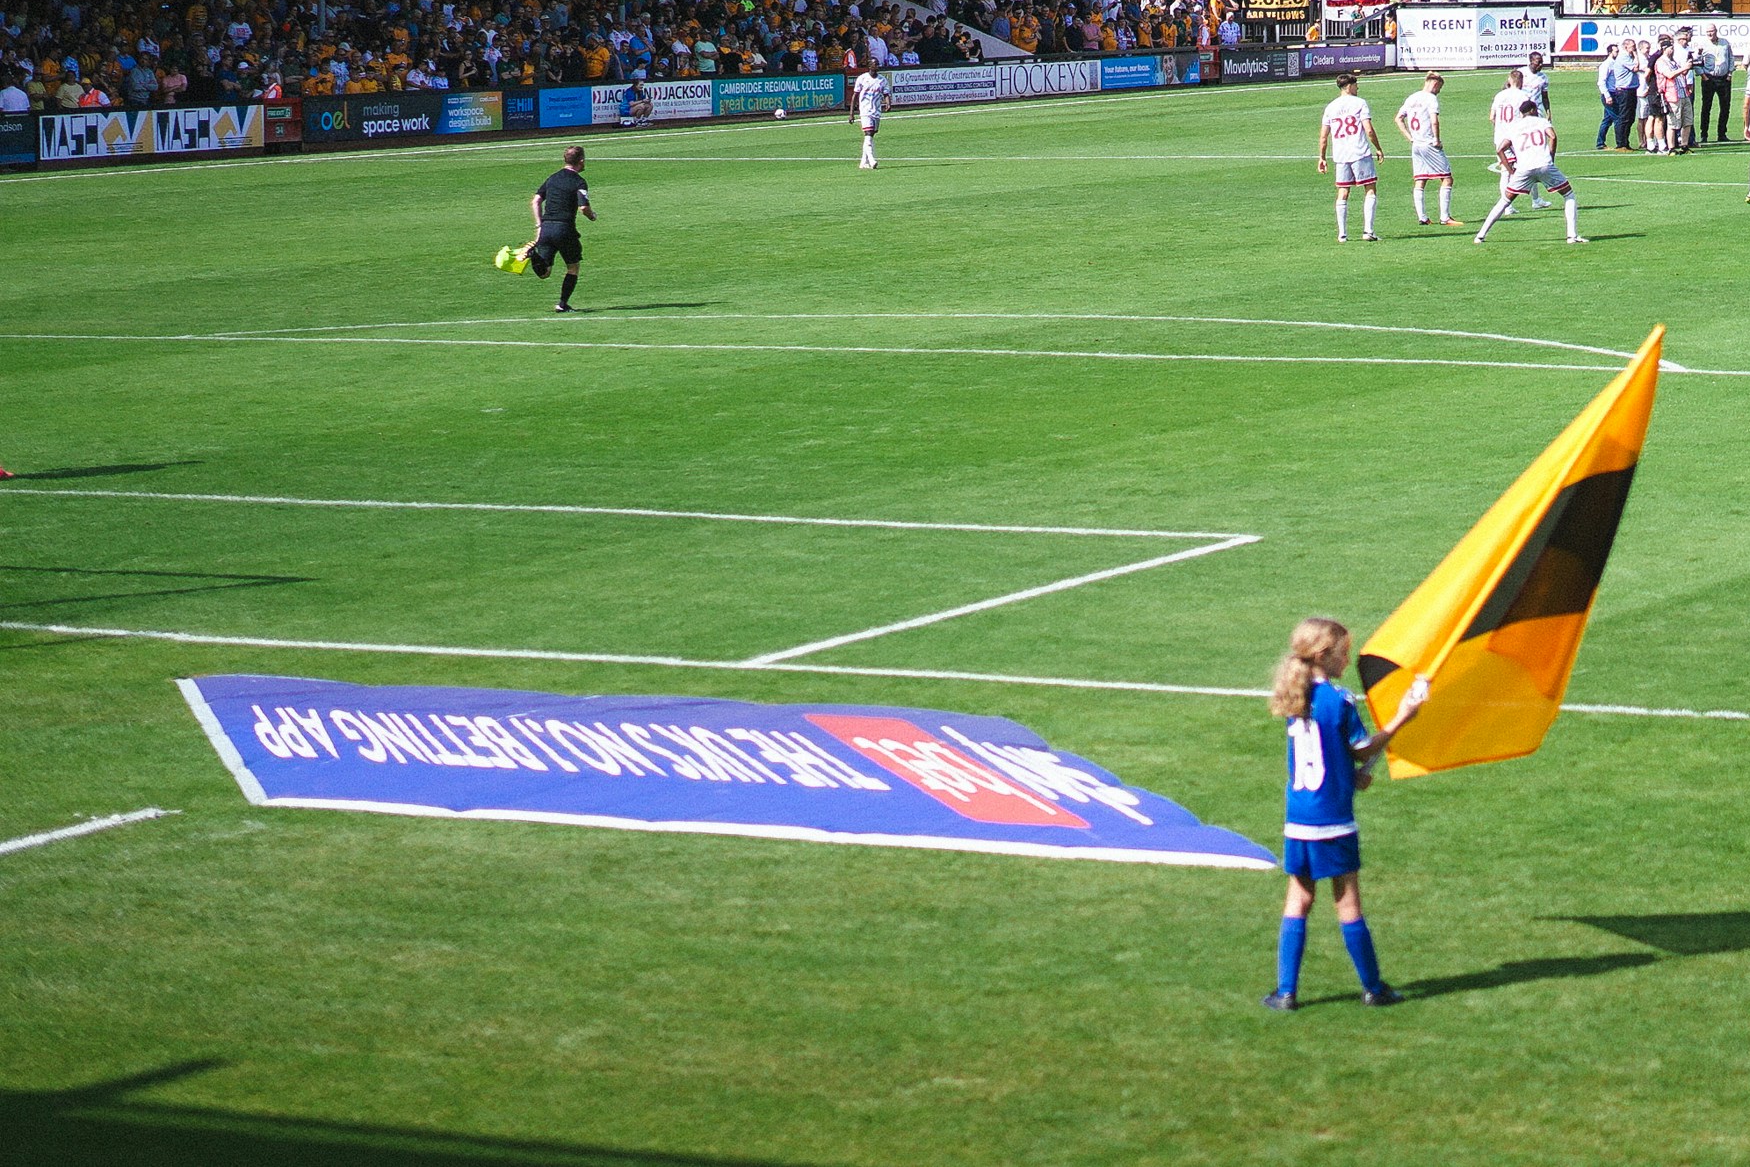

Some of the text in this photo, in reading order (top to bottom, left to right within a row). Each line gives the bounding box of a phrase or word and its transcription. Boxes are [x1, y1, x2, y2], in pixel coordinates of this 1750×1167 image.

[1337, 9, 1344, 18] F
[1422, 19, 1473, 30] REGENT
[1603, 24, 1642, 36] ALAN
[1416, 46, 1473, 54] 01223 711853
[1495, 43, 1517, 51] 01223
[1224, 57, 1268, 77] Movolytics
[1313, 53, 1335, 66] Cledara
[905, 69, 940, 85] Groundworks
[949, 69, 981, 82] Construction
[1000, 62, 1088, 96] HOCKEYS
[662, 84, 711, 101] JACKSON
[719, 81, 763, 95] CAMBRIDGE
[764, 80, 800, 93] REGIONAL
[802, 78, 834, 92] COLLEGE
[362, 101, 400, 118] making
[516, 97, 534, 112] Hill
[719, 95, 745, 115] great
[747, 96, 783, 110] careers
[786, 93, 810, 108] start
[812, 91, 834, 106] here
[448, 106, 484, 118] workspace
[1498, 104, 1514, 123] 10
[362, 114, 430, 137] space work
[448, 117, 470, 130] design
[475, 115, 492, 126] build
[1331, 115, 1359, 139] 28
[1410, 112, 1420, 132] 6
[1519, 129, 1544, 151] 20
[250, 704, 341, 760] APP
[329, 709, 550, 771] BETTING
[728, 728, 891, 791] THE
[852, 726, 1154, 826] sky bet
